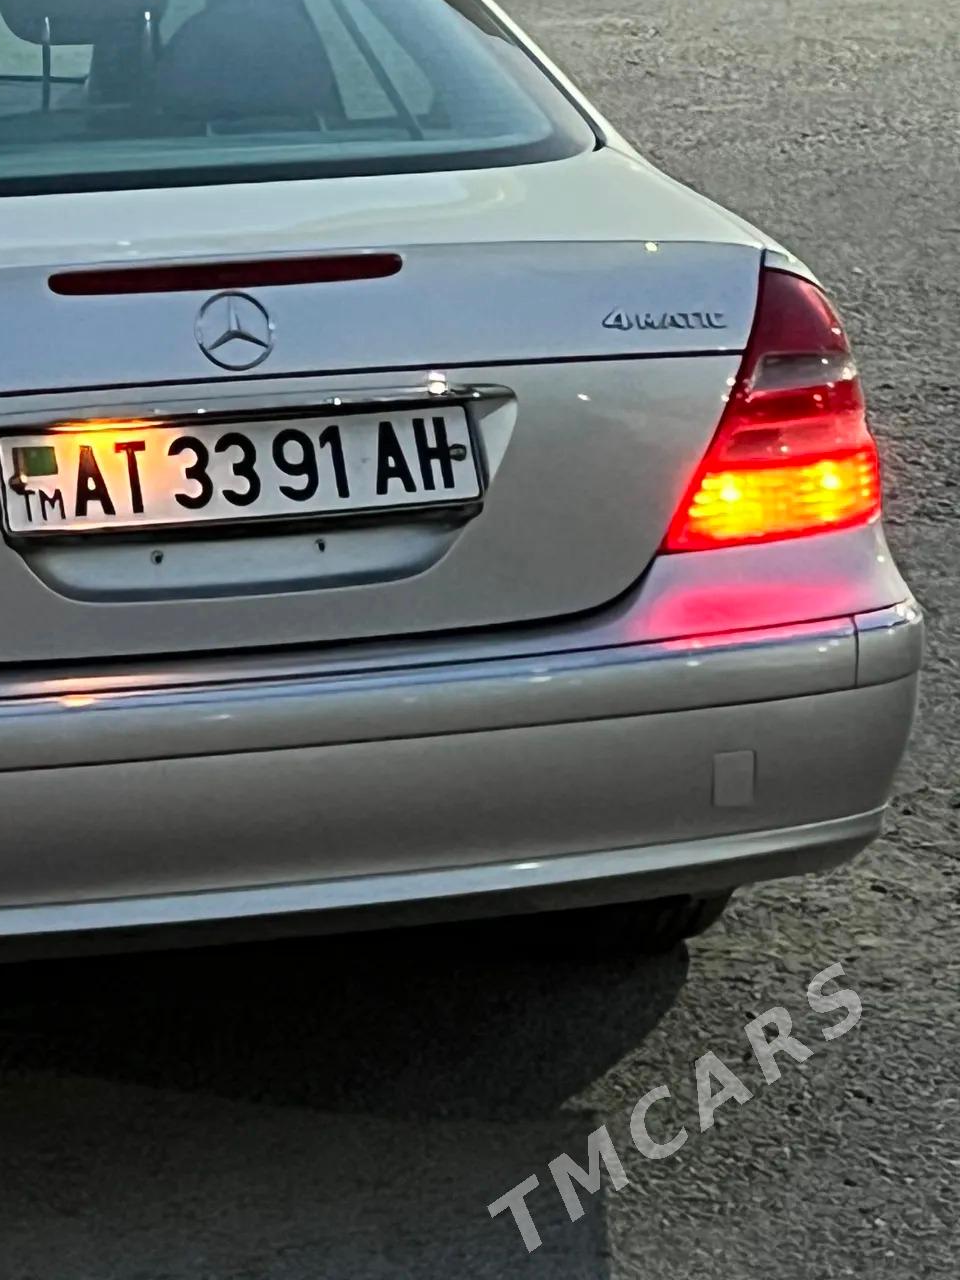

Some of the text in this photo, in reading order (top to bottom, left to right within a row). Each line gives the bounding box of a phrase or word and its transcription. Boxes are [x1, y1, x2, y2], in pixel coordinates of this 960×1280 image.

[75, 416, 455, 517] AT 3391 AH
[17, 488, 66, 522] TM
